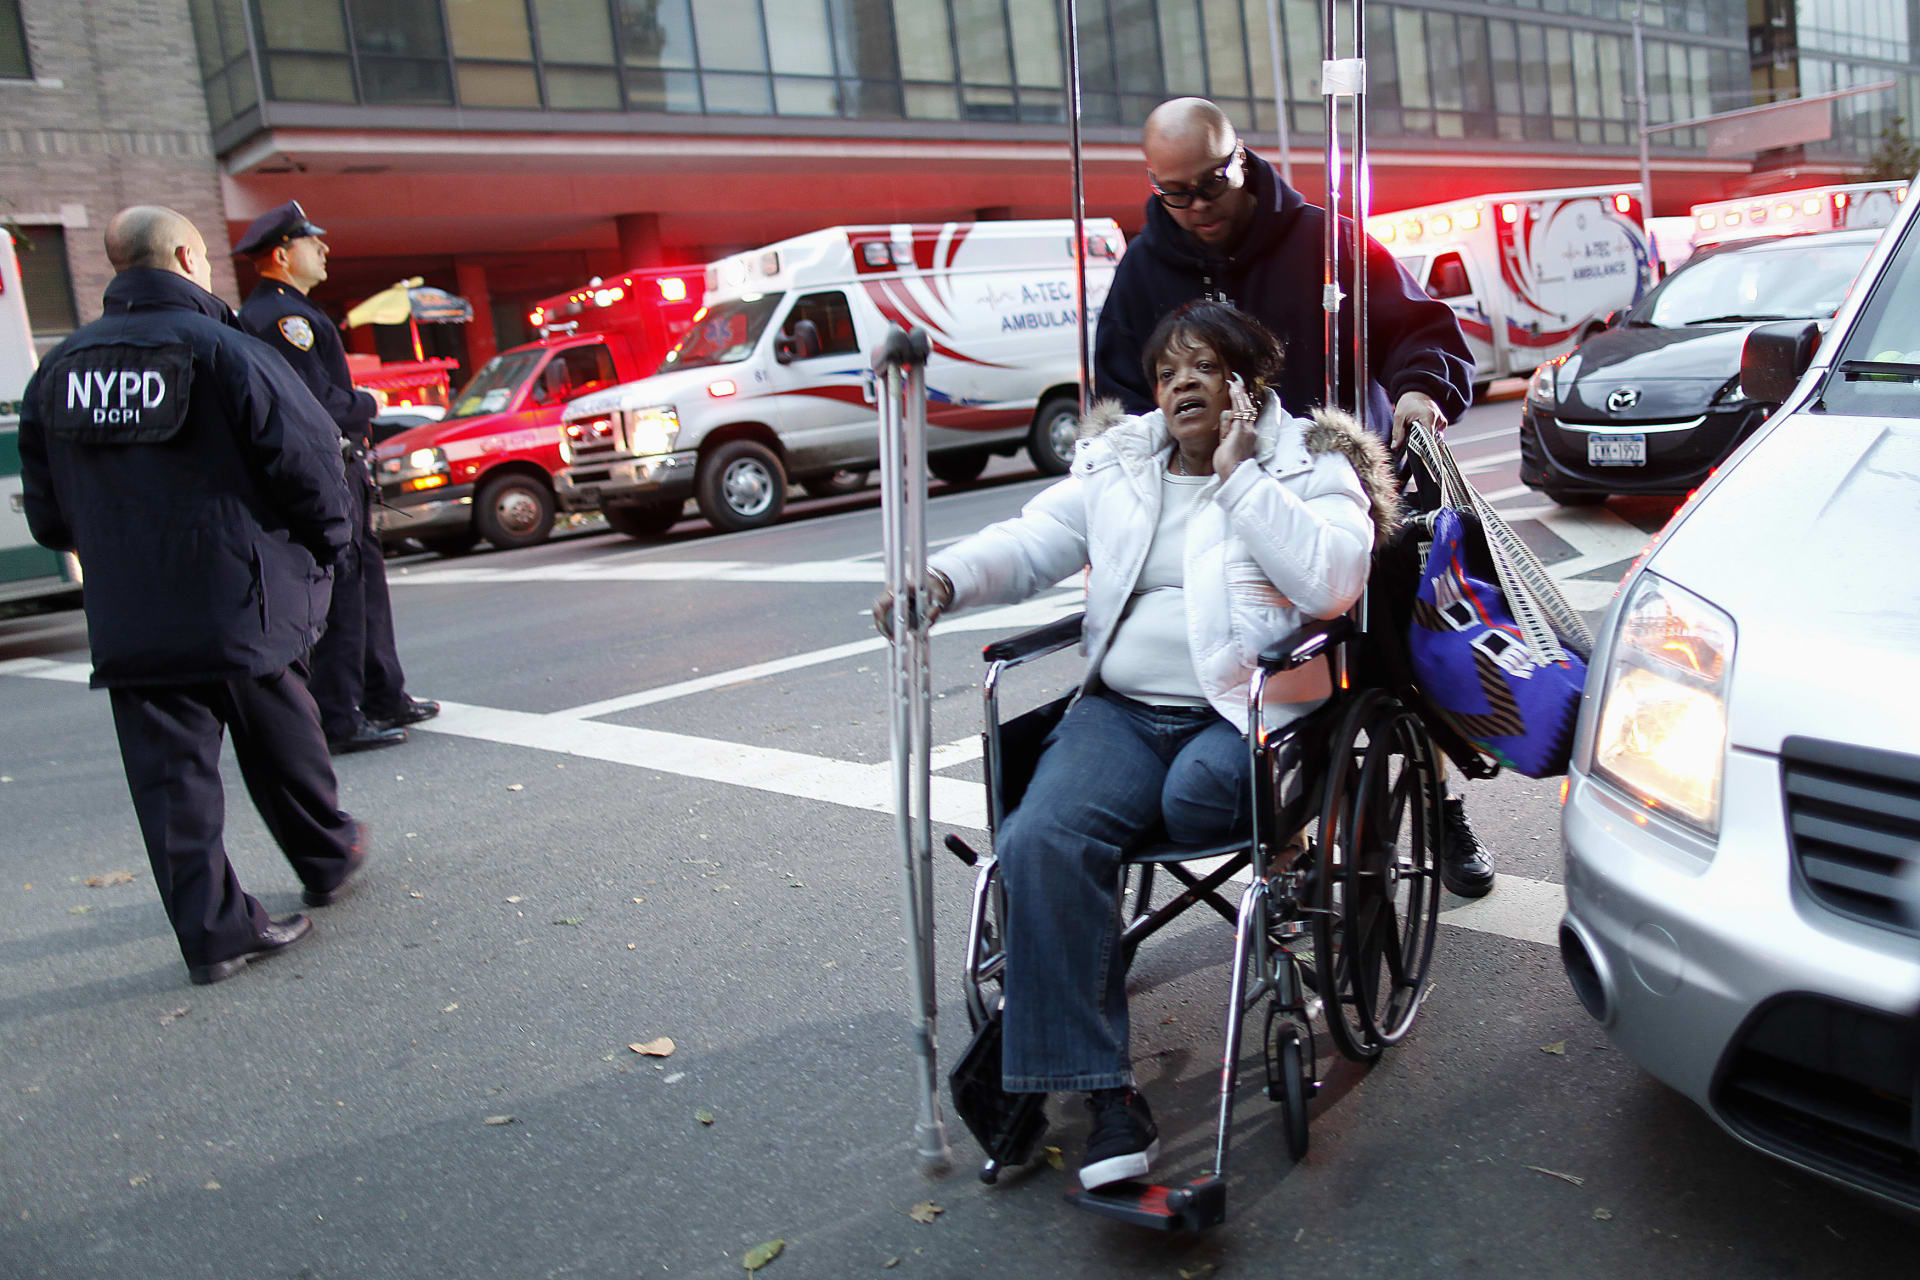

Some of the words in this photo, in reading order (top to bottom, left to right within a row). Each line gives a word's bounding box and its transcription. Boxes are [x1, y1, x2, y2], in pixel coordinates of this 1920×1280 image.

[1573, 261, 1627, 280] AMBULANCE
[1021, 281, 1071, 304] A-TEC
[67, 370, 166, 409] NYPD
[93, 408, 140, 424] DCPI
